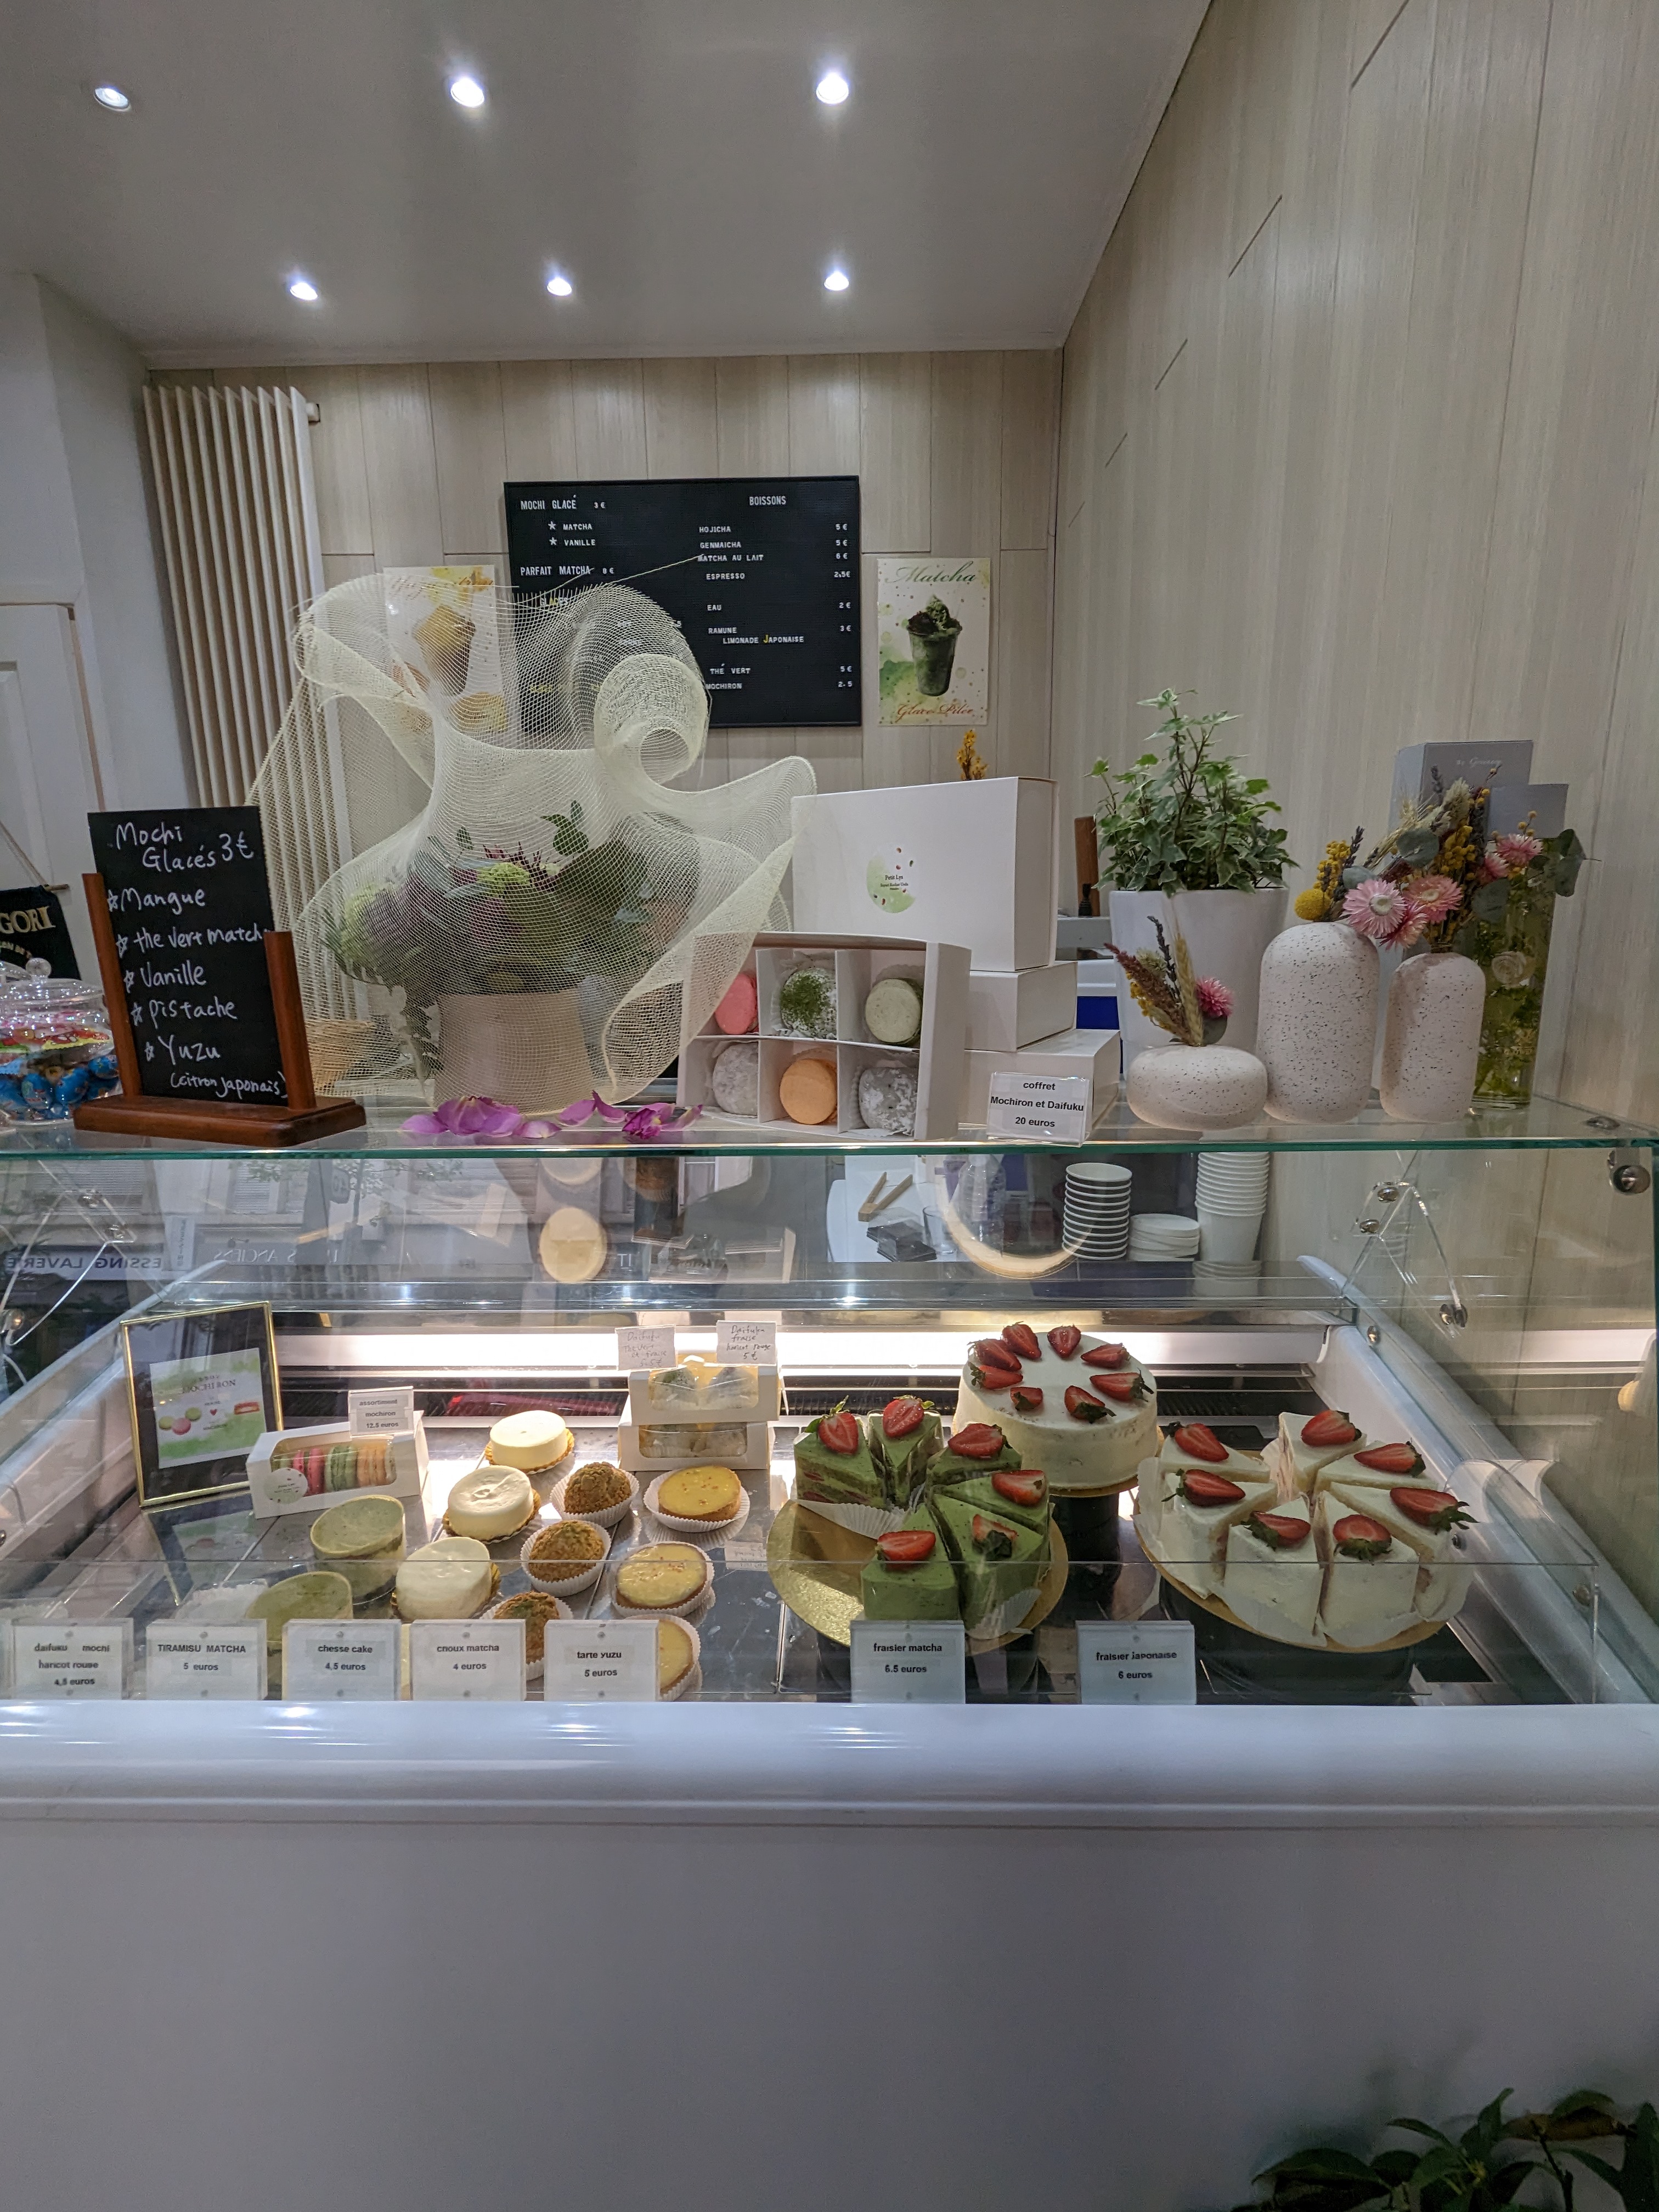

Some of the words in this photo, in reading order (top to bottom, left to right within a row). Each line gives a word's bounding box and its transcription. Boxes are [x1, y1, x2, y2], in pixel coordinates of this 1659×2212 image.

[521, 500, 545, 510] MOCHI
[552, 494, 576, 510] GLACÉ
[749, 496, 786, 506] BOISSONS
[521, 566, 551, 575] PARFAIT
[559, 566, 590, 575] MATCHA
[884, 561, 977, 583] Matcha
[710, 663, 724, 674] THÉ
[116, 822, 182, 849] Mochi
[121, 888, 206, 915] Mangue
[157, 1035, 221, 1065] Yuzu
[1023, 1081, 1056, 1091] coffret
[991, 1096, 1033, 1107] Mochiron
[1048, 1101, 1084, 1111] Daifuku
[1015, 1116, 1026, 1125] 20
[1029, 1118, 1056, 1127] euros
[873, 1643, 906, 1651] fraisier
[1096, 1652, 1129, 1661] fraisier
[1131, 1651, 1177, 1660] japonaise
[38, 1660, 70, 1668] haricot
[885, 1664, 898, 1673] 6.5
